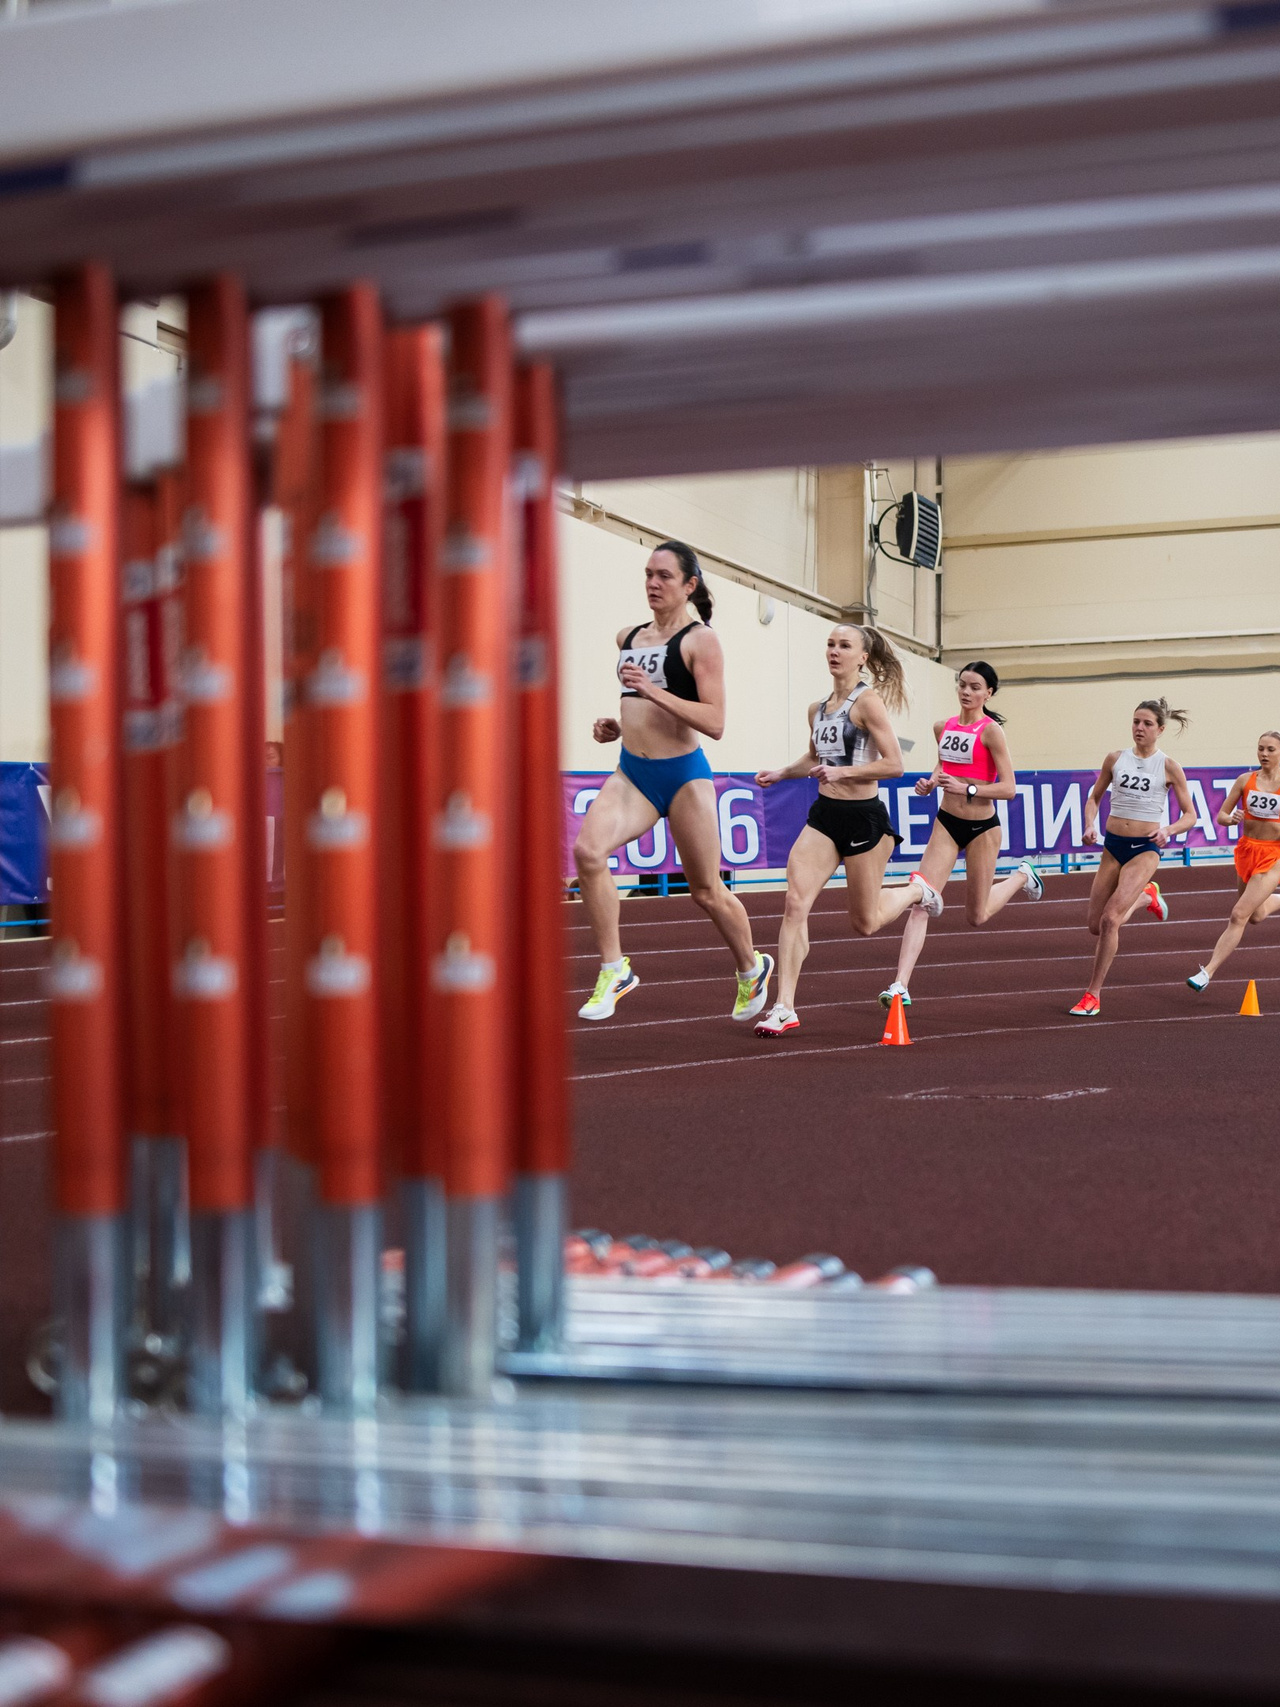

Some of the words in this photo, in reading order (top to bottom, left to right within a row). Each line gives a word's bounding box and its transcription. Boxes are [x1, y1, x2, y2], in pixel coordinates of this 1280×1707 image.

[815, 726, 838, 744] 143
[941, 735, 969, 753] 286
[1119, 773, 1151, 792] 223
[1249, 795, 1278, 811] 239
